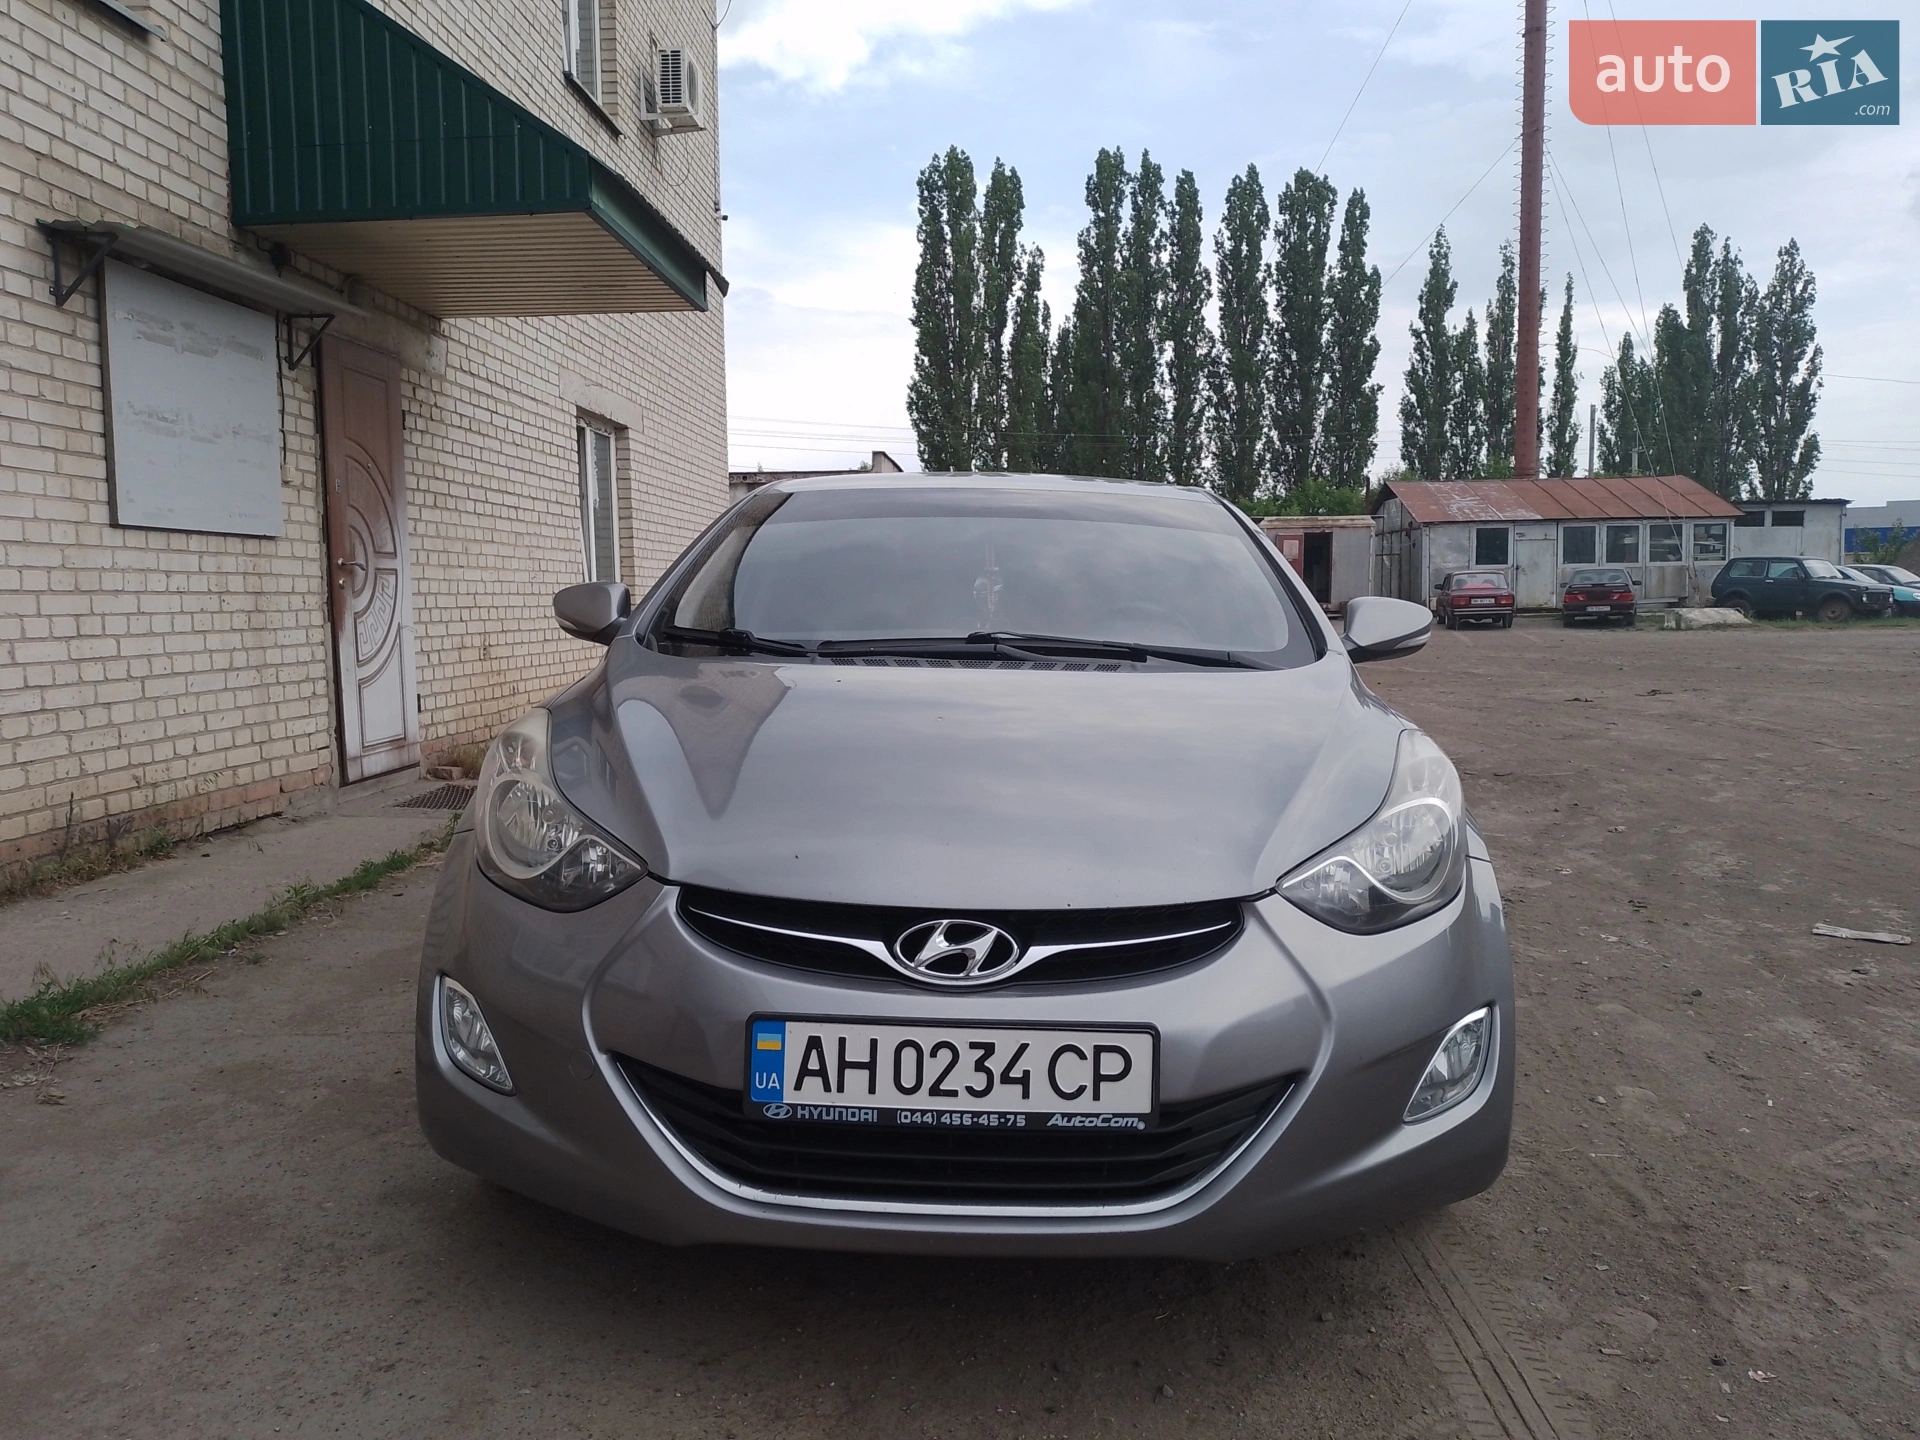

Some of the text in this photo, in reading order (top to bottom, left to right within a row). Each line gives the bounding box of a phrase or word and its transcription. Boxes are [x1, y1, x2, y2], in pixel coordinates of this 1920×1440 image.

[793, 1035, 1133, 1102] AH 0234 CP
[755, 1072, 781, 1090] UA
[797, 1105, 1139, 1128] HYUNDAI (044) 456-45-75 AutoCom
